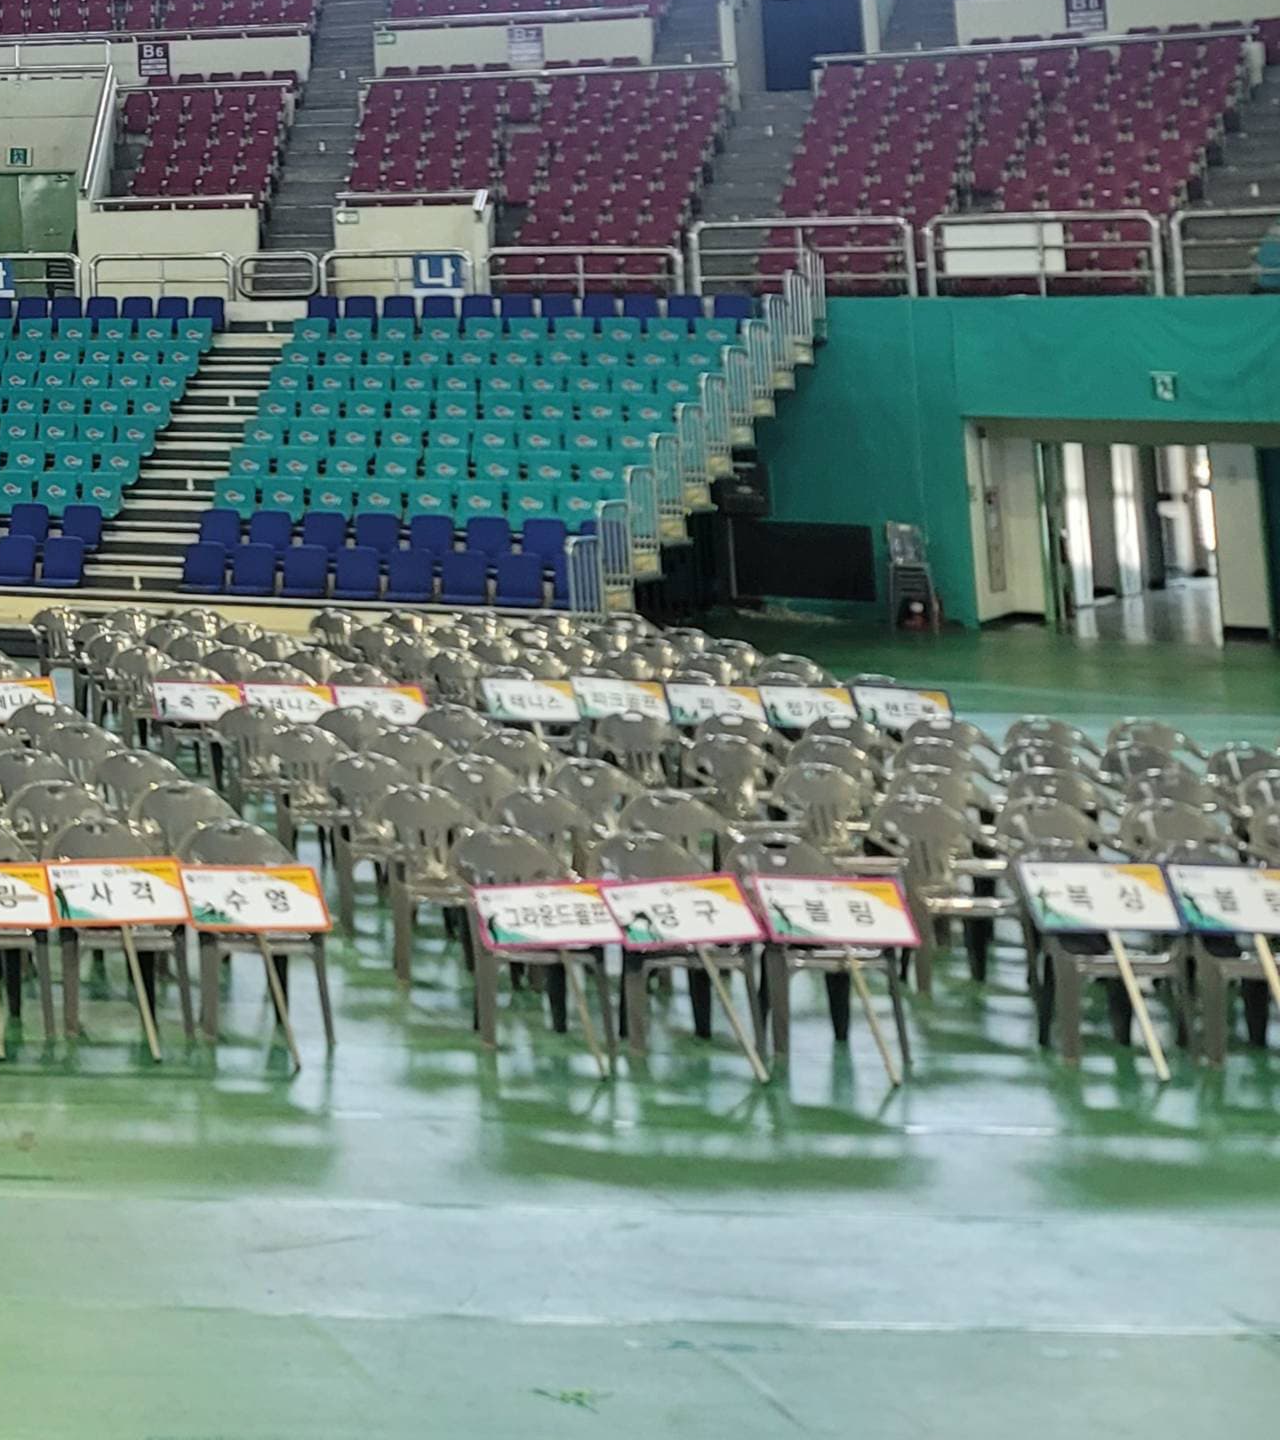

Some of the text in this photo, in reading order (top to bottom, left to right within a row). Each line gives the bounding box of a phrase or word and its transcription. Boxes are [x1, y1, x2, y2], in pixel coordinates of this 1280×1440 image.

[143, 44, 165, 58] B6
[419, 257, 456, 288] 나
[591, 691, 658, 712] 파크골프
[507, 903, 611, 928] 그라운드골프
